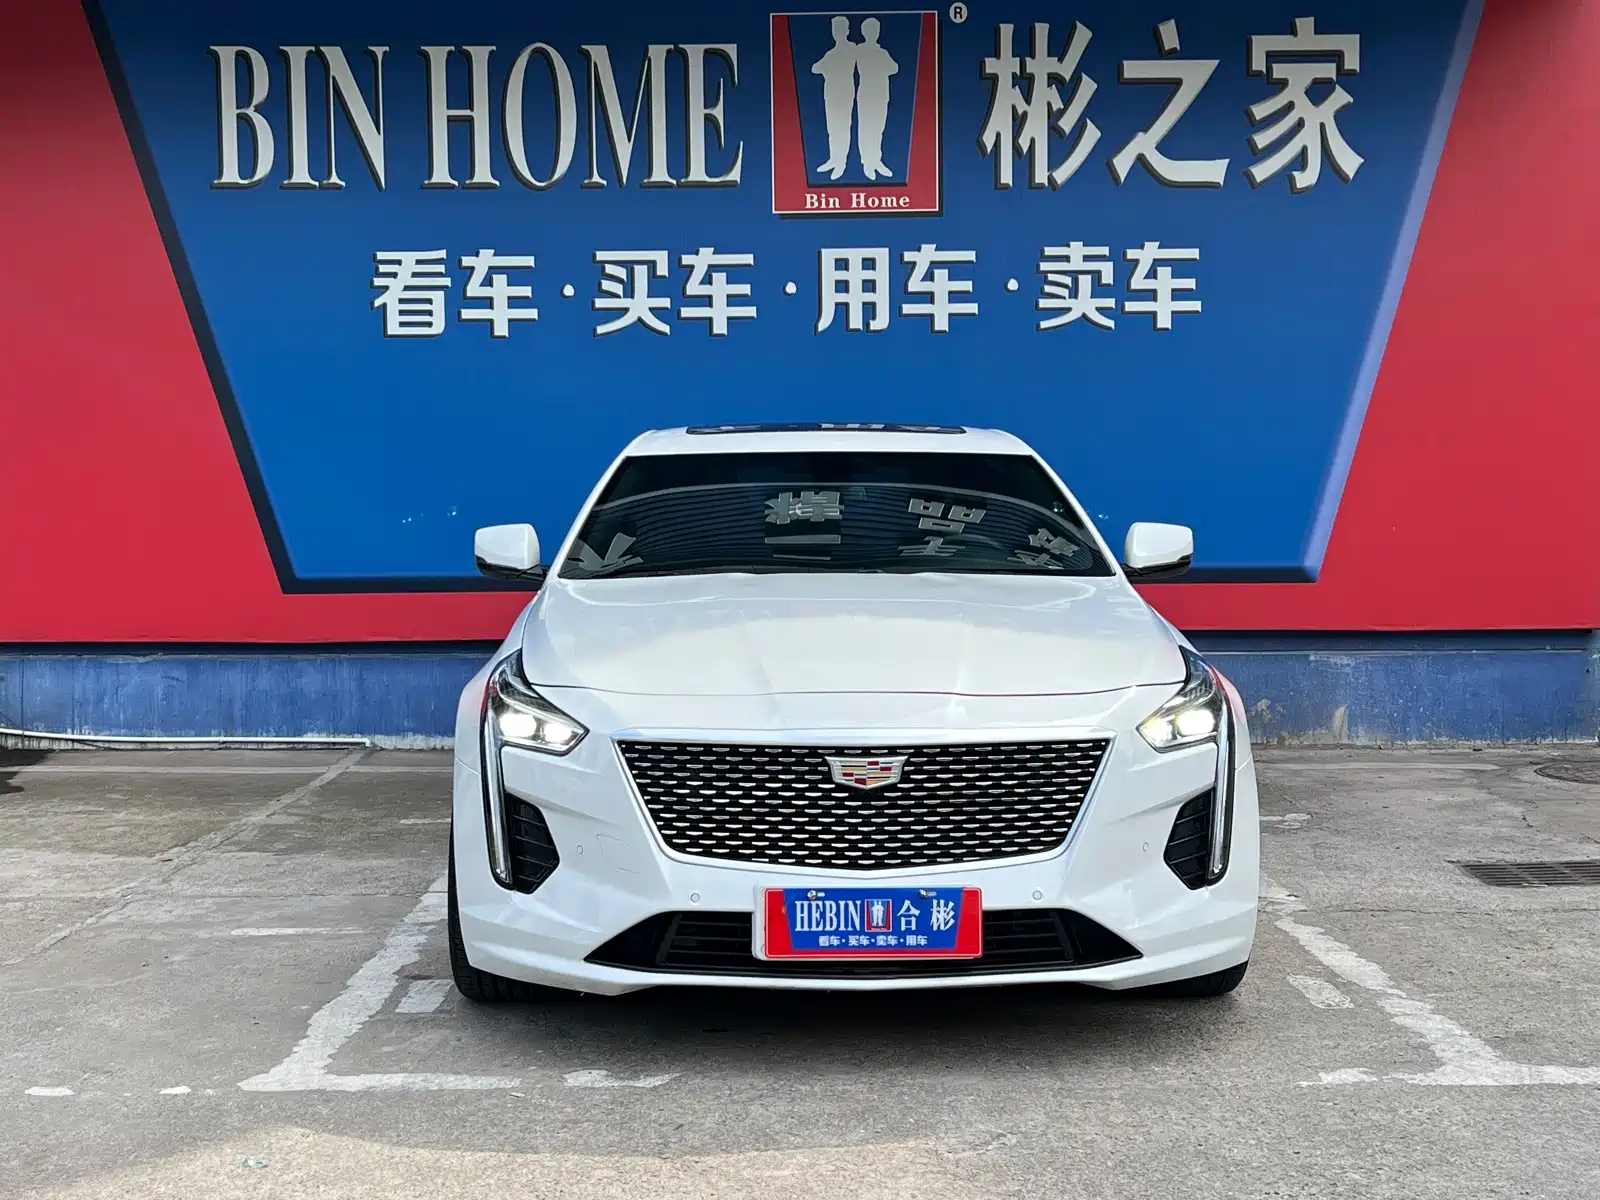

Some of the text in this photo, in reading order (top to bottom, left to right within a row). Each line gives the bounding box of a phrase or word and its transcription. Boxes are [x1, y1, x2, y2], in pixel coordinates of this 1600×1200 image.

[208, 42, 744, 190] BIN HOME
[977, 17, 1365, 194] 彬之家
[804, 192, 911, 209] Bin Home
[795, 900, 862, 931] HEBIN
